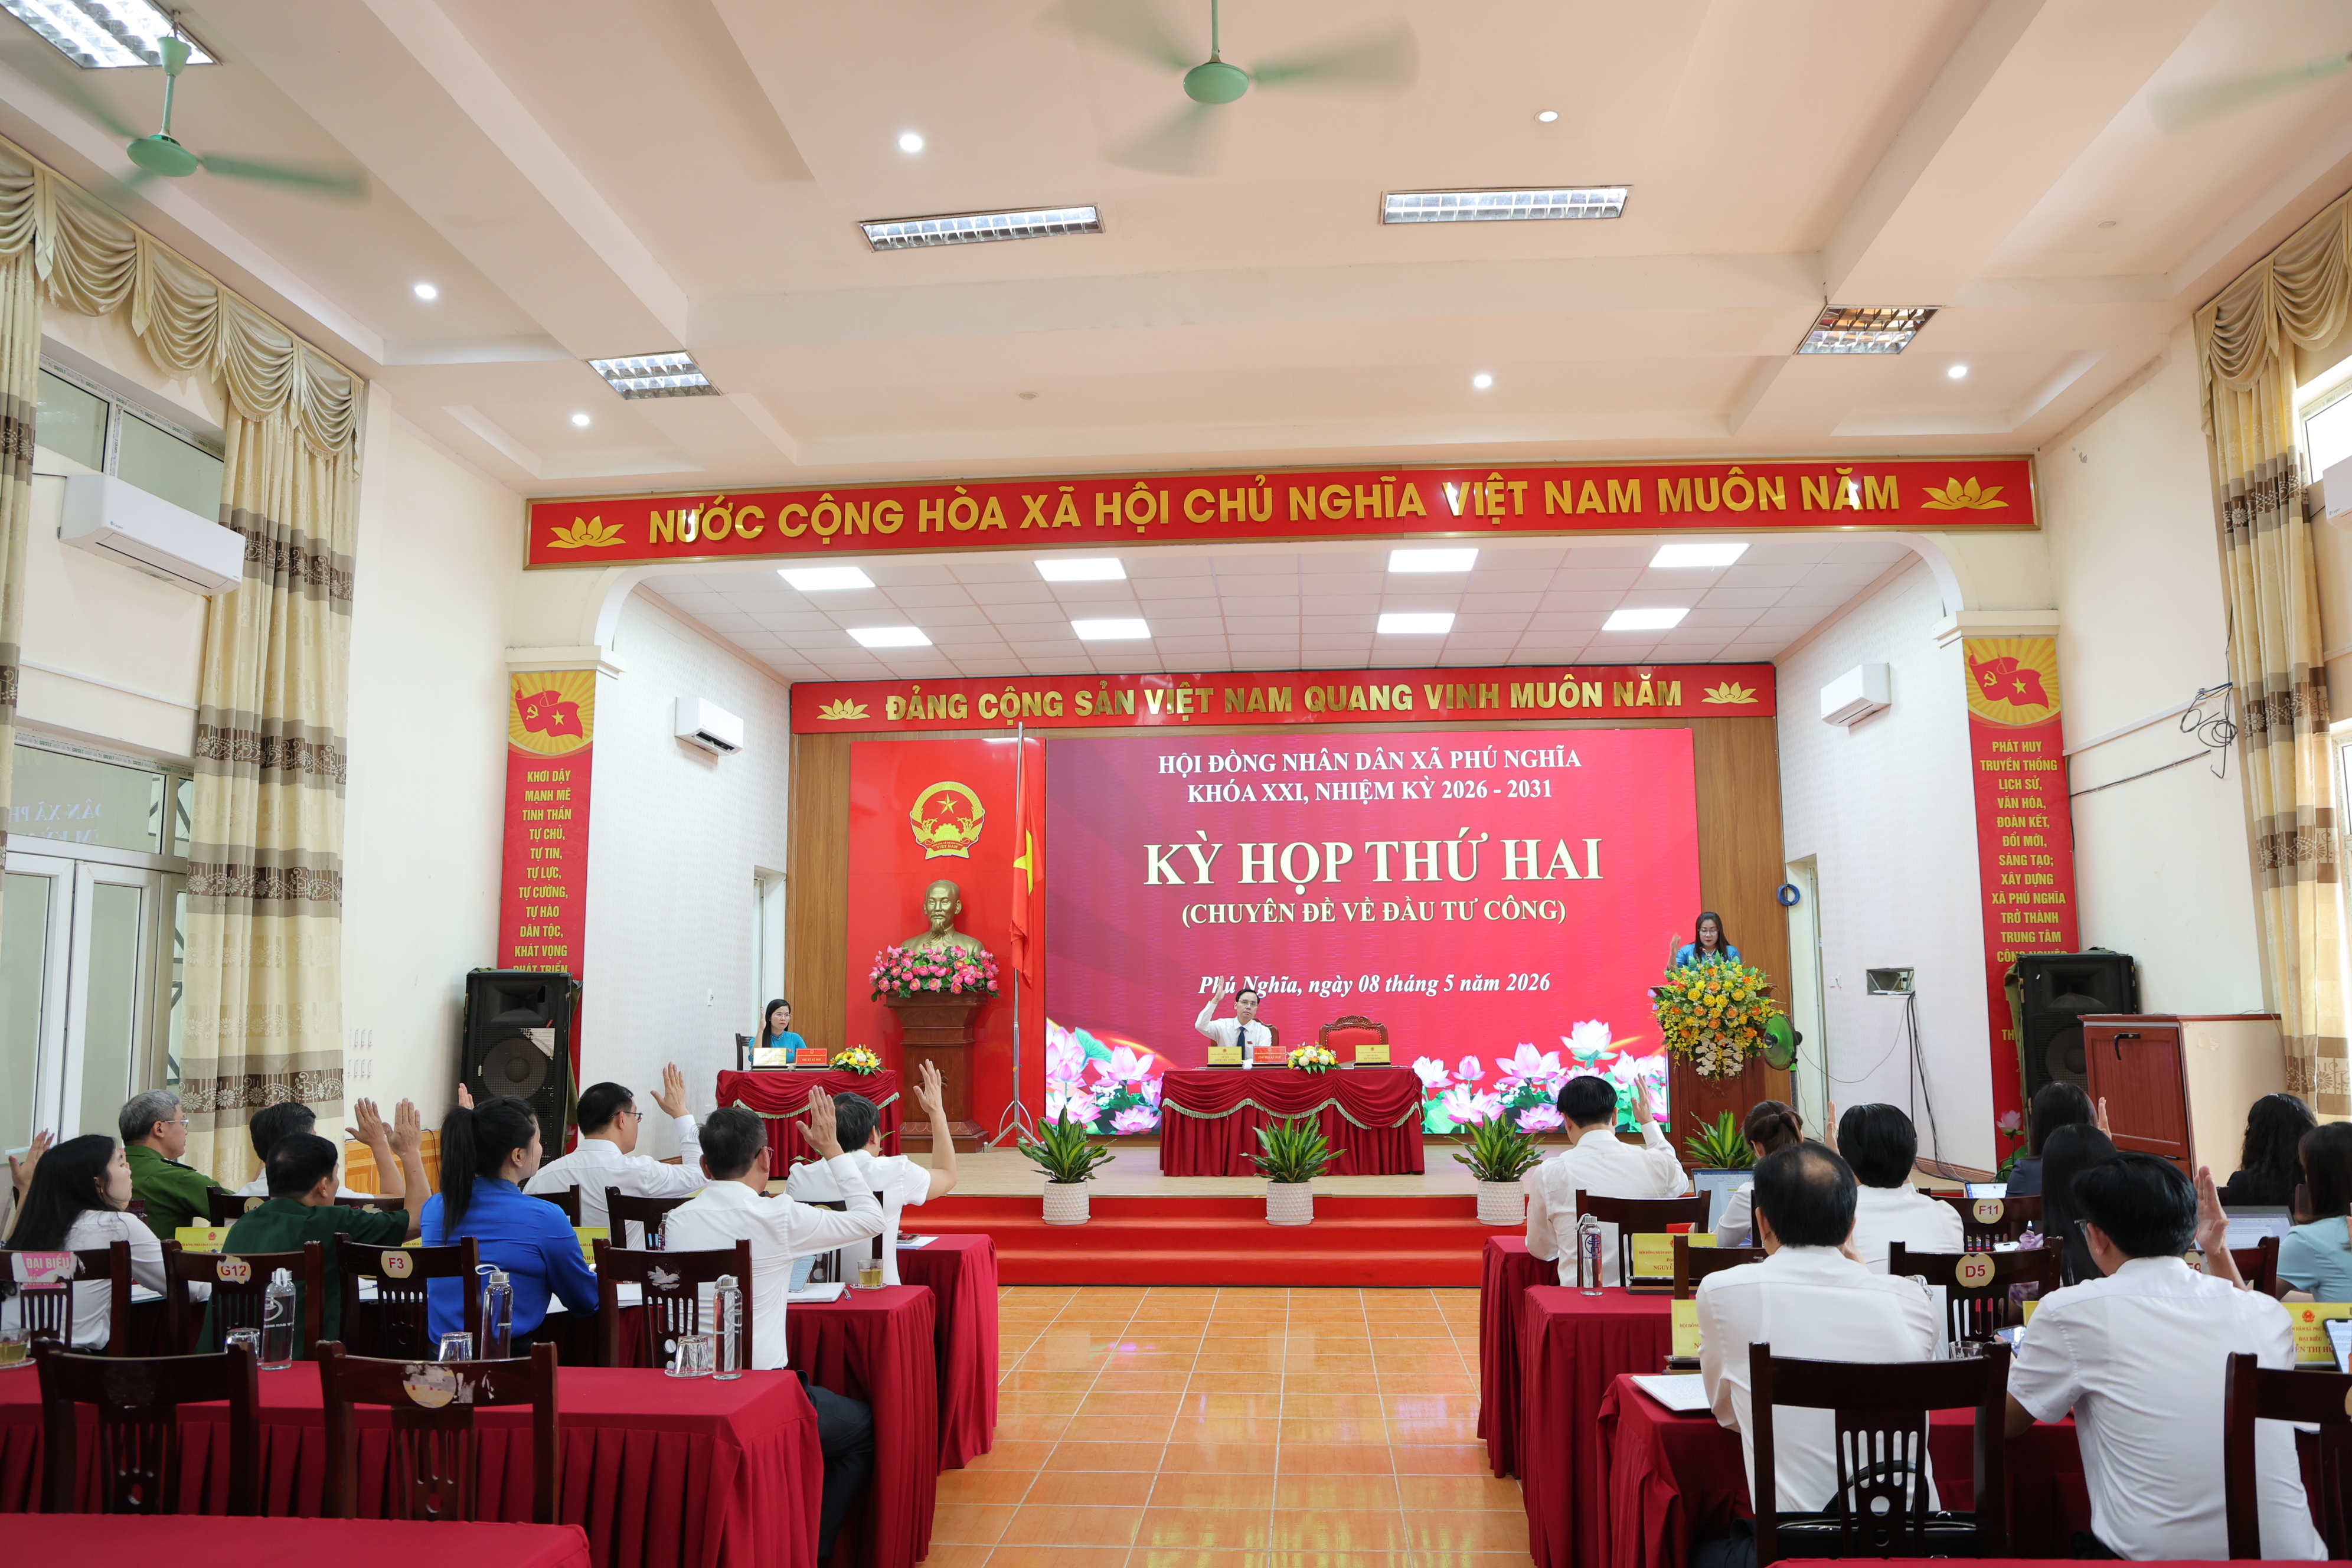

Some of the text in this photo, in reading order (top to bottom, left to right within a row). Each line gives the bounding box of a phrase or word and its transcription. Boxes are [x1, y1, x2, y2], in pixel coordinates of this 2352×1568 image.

[649, 468, 1899, 544] NƯỚC CỘNG HÒA XÃ HỘI CHỦ NGHĨA VIỆT NAM MUÔN NĂM
[886, 673, 1681, 726] ĐẢNG CỘNG SẢN VIỆT NAM QUANG VINH MUÔN NĂM
[1992, 740, 2042, 752] PHÁT HUY
[1158, 744, 1582, 778] HỘI ĐỒNG NHÂN DÂN XÃ PHÚ NGHĨA
[1980, 756, 2058, 771] TRUYỀN THỐNG
[527, 769, 571, 783] KHƠI DẬY
[1187, 778, 1257, 803] KHÓA
[1262, 783, 1309, 805] XXI,
[1315, 779, 1396, 805] NHIỆM
[1402, 776, 1435, 799] KỲ
[1442, 779, 1488, 799] 2026
[1507, 779, 1553, 798] 2031
[1999, 776, 2043, 792] LỊCH SỬ,
[525, 788, 571, 803] MẠNH MẼ
[1998, 795, 2046, 809] VĂN HÓA,
[522, 805, 571, 821] TINH THẦN
[1997, 813, 2050, 828] ĐOÀN KẾT,
[530, 825, 565, 842] TỰ CHỦ,
[2003, 831, 2047, 847] ĐỔI MỚI,
[530, 847, 563, 861] TỰ TIN,
[1144, 827, 1604, 895] KỲ HỌP THỨ HAI
[1999, 853, 2054, 868] SÁNG TẠO;
[527, 867, 562, 880] TỰ LỰC,
[2001, 871, 2054, 887] XÂY DỰNG
[519, 885, 568, 900] TỰ CƯỜNG,
[1992, 890, 2066, 904] XÃ PHÚ NGHĨA
[526, 904, 559, 920] TỰ HÀO
[1182, 894, 1566, 929] (CHUYÊN ĐỀ VỀ ĐẦU TƯ CÔNG)
[2001, 909, 2059, 923] TRỞ THÀNH
[520, 923, 563, 938] DÂN TỘC,
[2001, 929, 2062, 943] TRUNG TÂM
[515, 943, 567, 959] KHÁT VỌNG
[1240, 976, 1302, 997] Nghĩa,
[1308, 975, 1353, 998] ngày
[1358, 974, 1380, 993] 08
[1385, 974, 1439, 997] tháng
[1444, 974, 1455, 992] 5
[1460, 974, 1500, 992] năm
[1506, 972, 1551, 991] 2026
[1979, 1205, 1999, 1215] F11
[26, 1253, 70, 1271] ĐẠI BIỂU
[387, 1257, 404, 1269] F3
[220, 1265, 247, 1276] G12
[1965, 1265, 1986, 1278] D5
